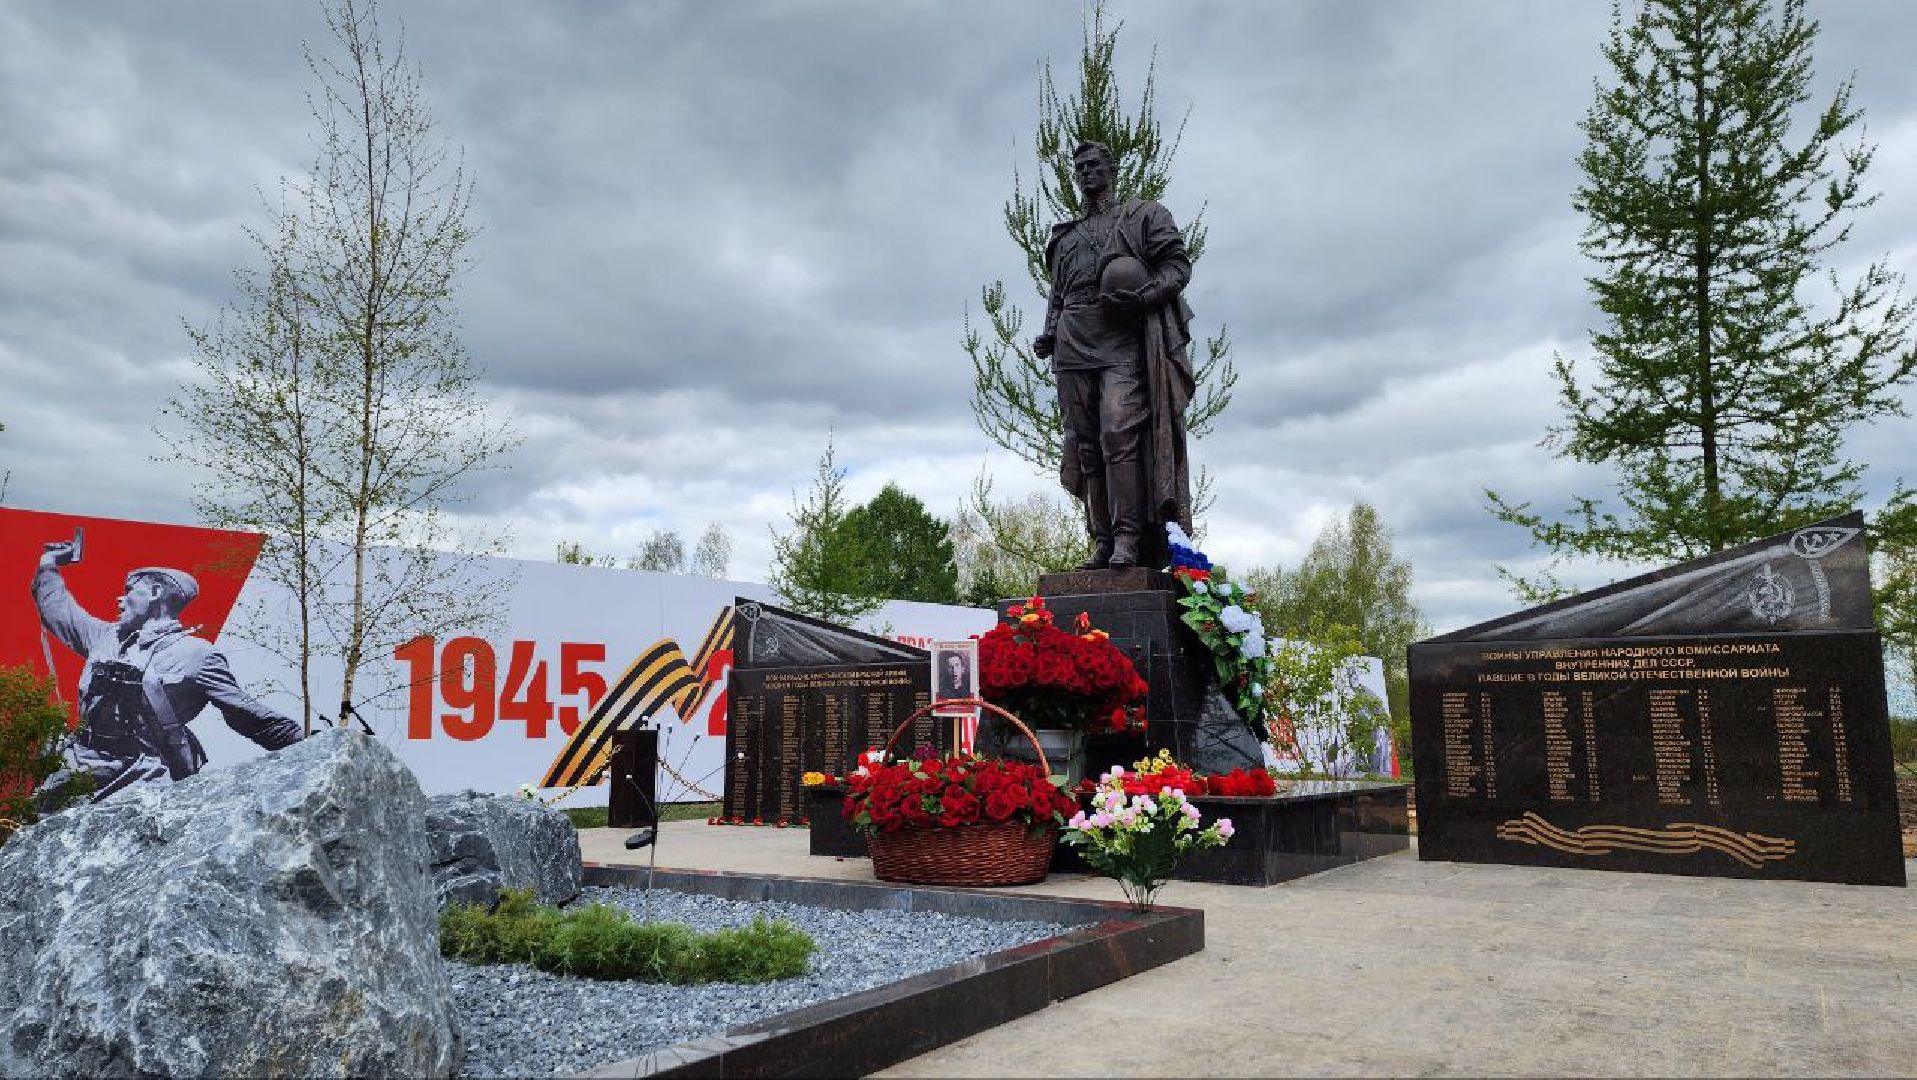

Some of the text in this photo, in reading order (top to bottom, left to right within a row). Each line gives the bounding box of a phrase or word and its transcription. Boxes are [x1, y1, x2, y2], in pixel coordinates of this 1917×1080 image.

[1525, 649, 1599, 660] УПРАВЛЕНИЯ
[1601, 647, 1675, 657] НАРОДНОГО
[1677, 643, 1781, 655] КОМИССАРИАТА
[1555, 659, 1631, 670] ВНУТРЕННИХ
[1633, 658, 1658, 669] ДЕЛ
[1538, 672, 1570, 682] ГОДЫ
[1573, 669, 1628, 681] ВЕЛИКОЙ
[1630, 667, 1738, 679] ОТЕЧЕСТВЕННОЙ
[1741, 666, 1790, 678] ВОЙНЫ
[394, 635, 608, 742] 1945
